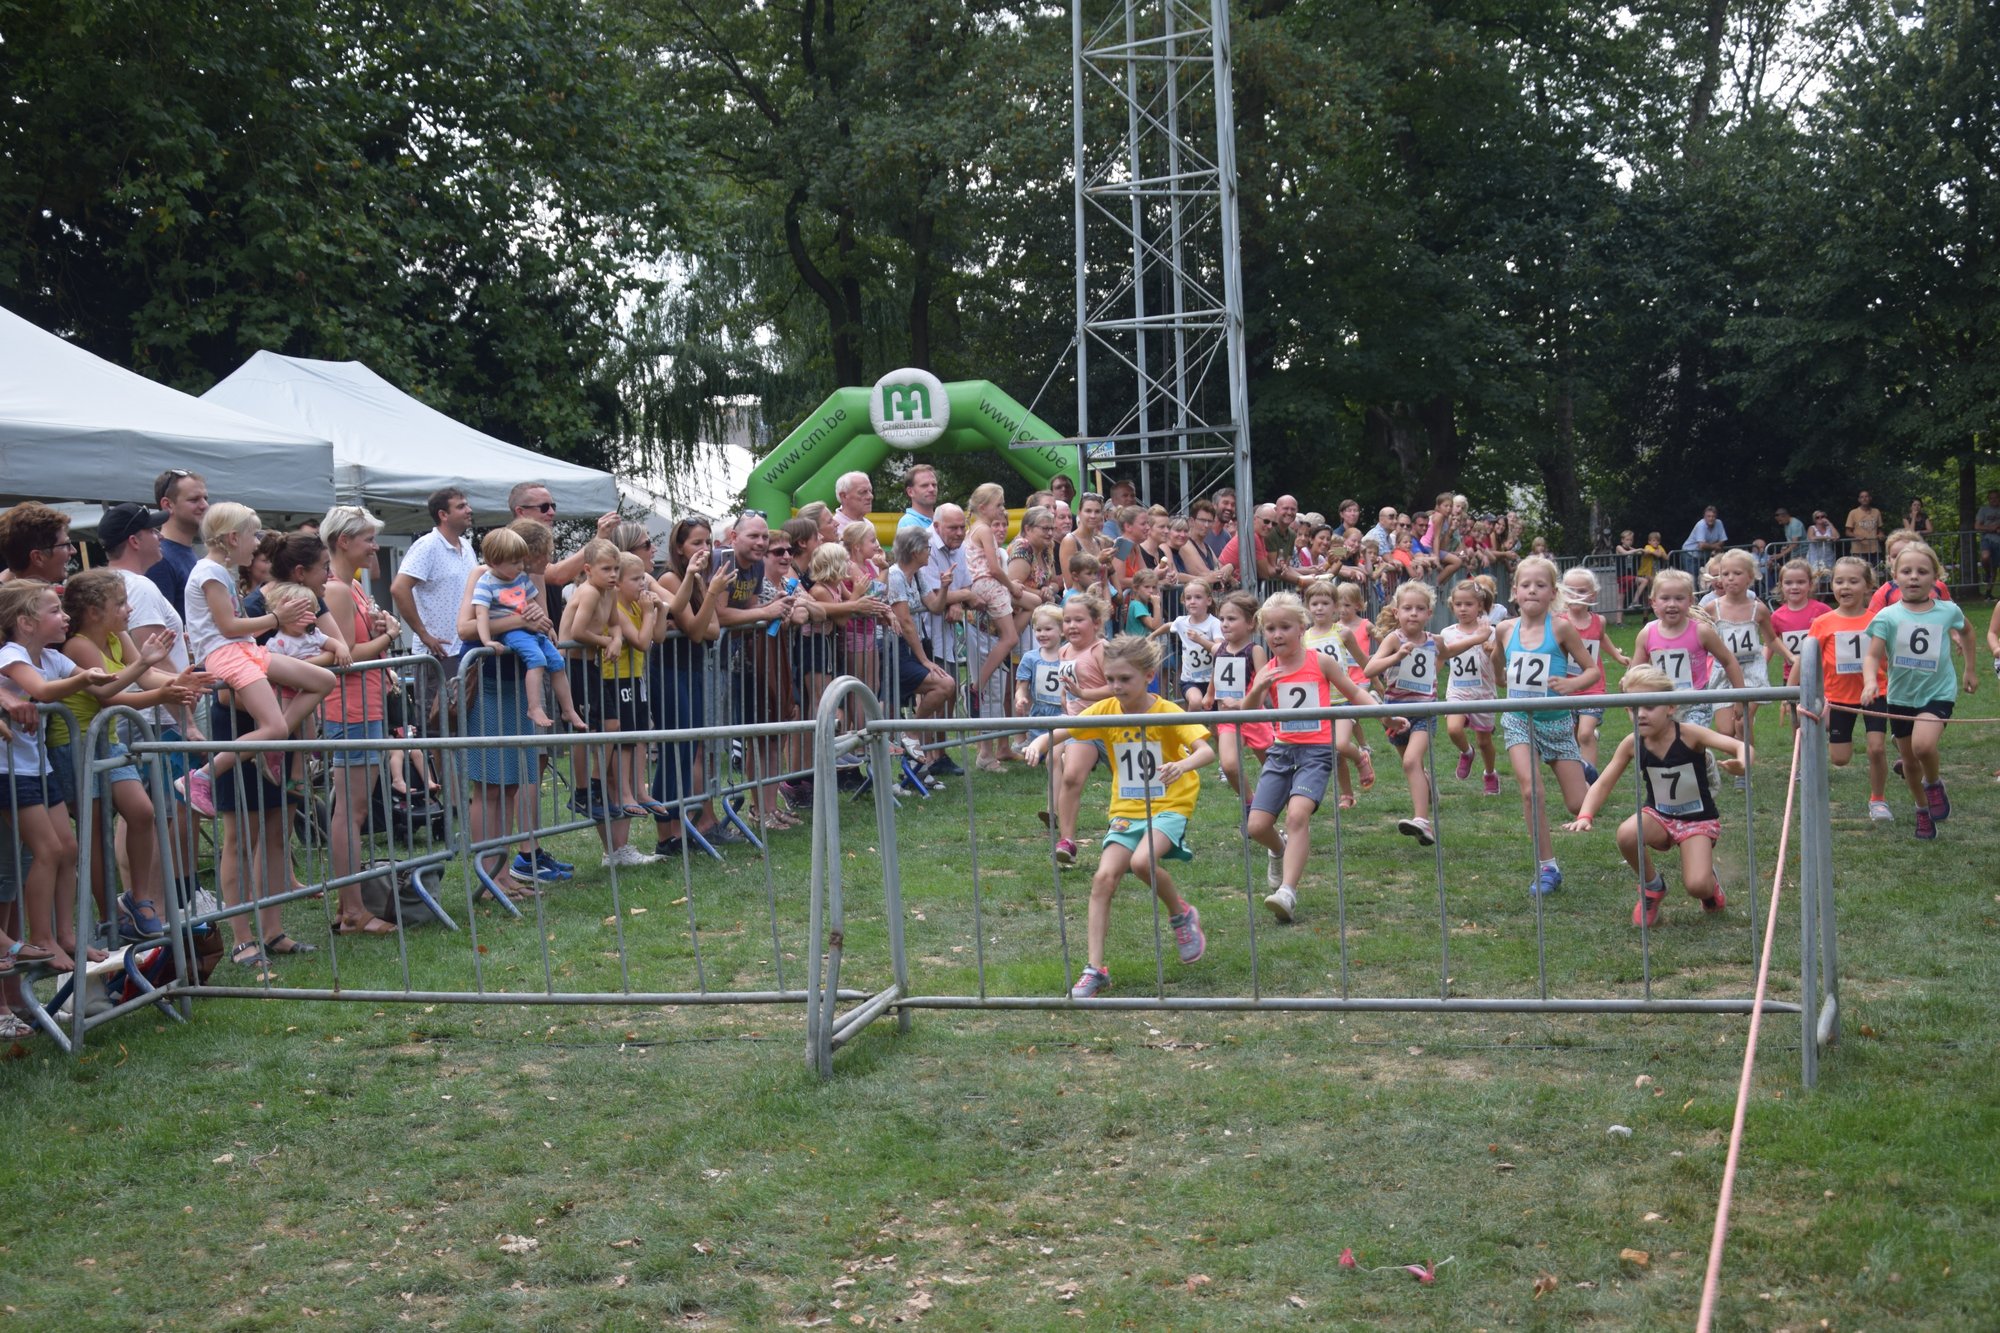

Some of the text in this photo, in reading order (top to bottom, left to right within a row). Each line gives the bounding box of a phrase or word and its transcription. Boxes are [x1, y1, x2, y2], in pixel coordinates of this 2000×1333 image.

[763, 408, 847, 484] www.cm.be
[1316, 644, 1339, 662] 8
[1728, 630, 1753, 653] 14
[1787, 633, 1808, 655] 2
[1848, 634, 1861, 660] 1
[1909, 627, 1930, 655] 6
[1189, 650, 1213, 668] 33
[1411, 653, 1427, 678] 8
[1453, 656, 1478, 677] 34
[1513, 656, 1544, 686] 12
[1656, 653, 1685, 678] 17
[1045, 670, 1060, 692] 5
[1220, 662, 1236, 687] 4
[1289, 686, 1307, 709] 2
[1120, 749, 1156, 781] 19
[1661, 771, 1681, 800] 7
